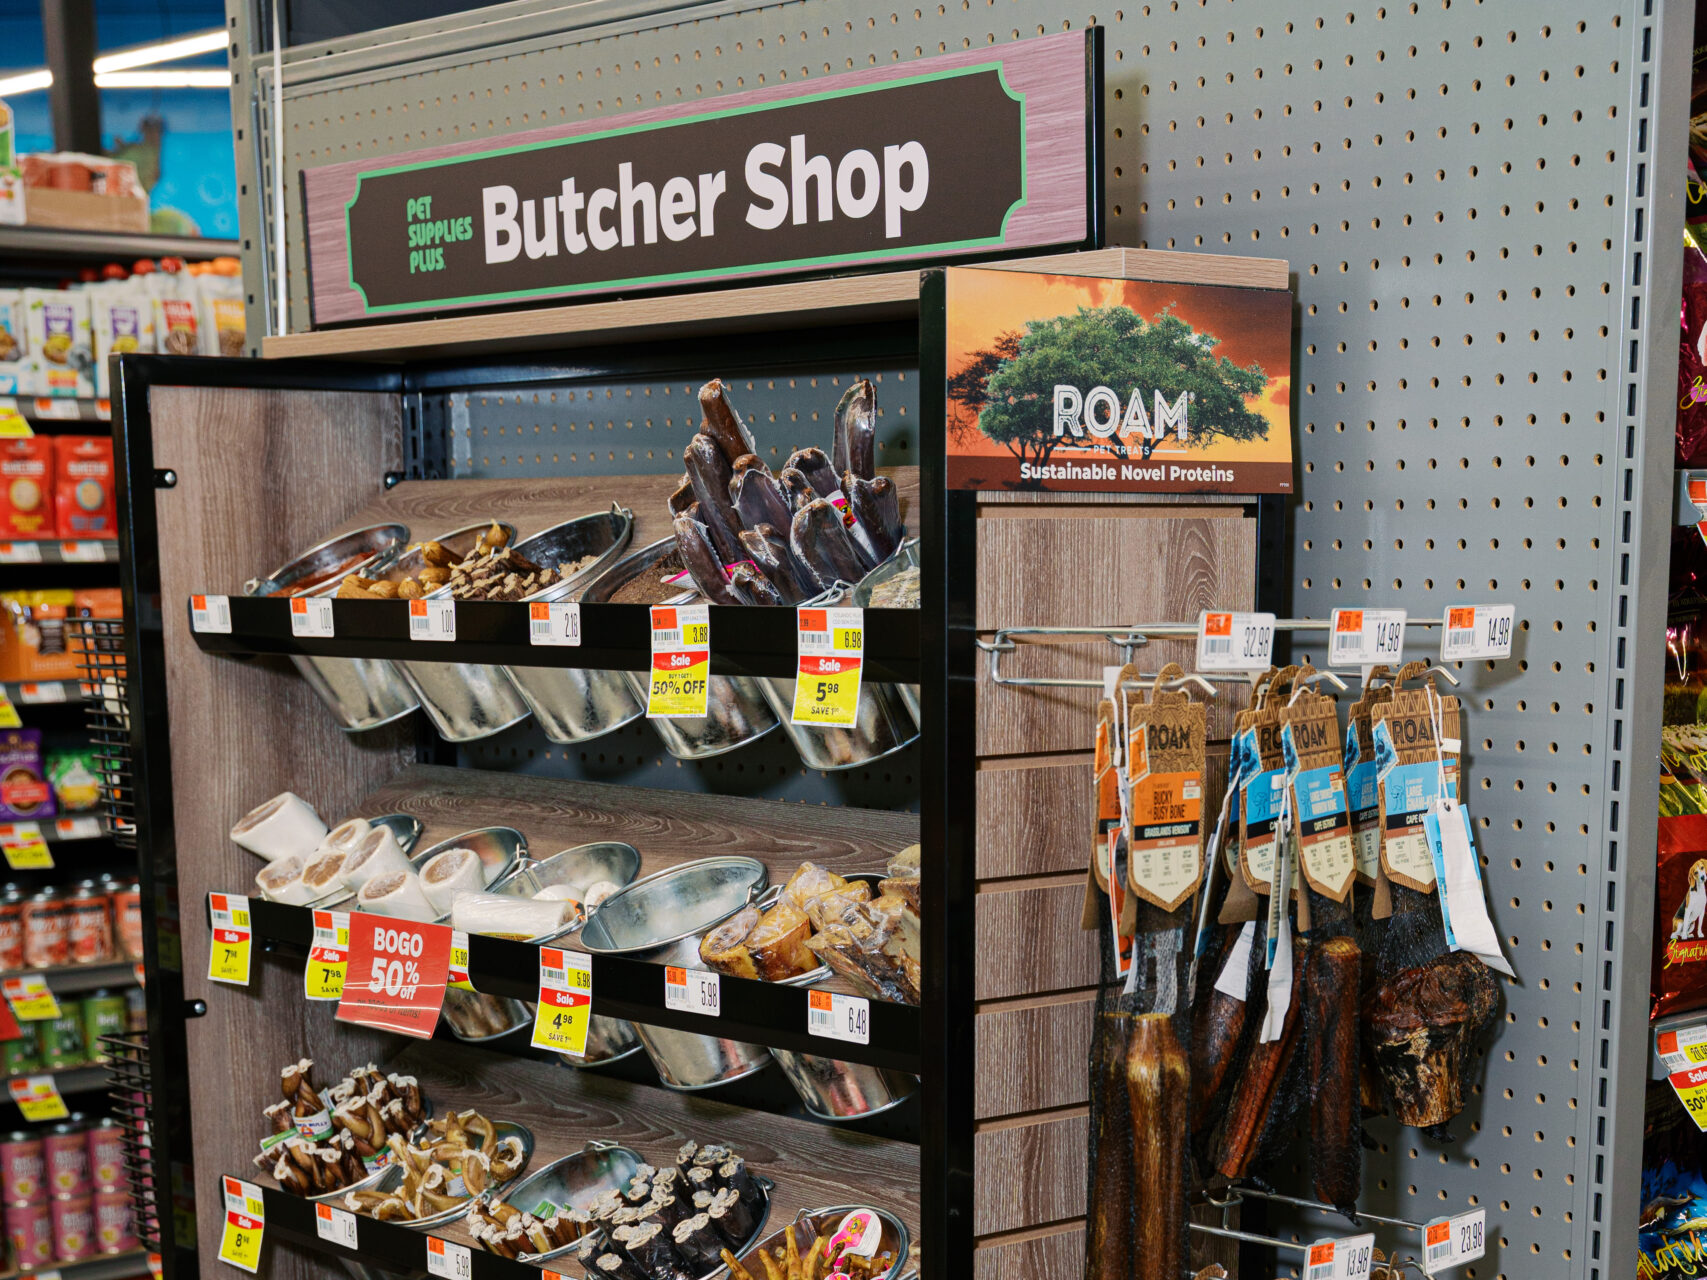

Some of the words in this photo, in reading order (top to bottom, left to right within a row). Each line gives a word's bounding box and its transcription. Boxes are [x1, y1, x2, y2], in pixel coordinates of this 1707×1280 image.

[406, 195, 432, 222] PET
[482, 162, 726, 265] Butcher
[744, 135, 929, 238] Shop
[408, 216, 474, 248] SUPPLIES
[409, 247, 445, 274] PLUS
[1053, 384, 1188, 440] ROAM
[1093, 445, 1113, 455] PET
[1115, 445, 1150, 456] TREATS
[1020, 462, 1118, 482] Sustainable
[1121, 464, 1166, 482] Novel
[1169, 464, 1235, 483] Proteins
[564, 612, 578, 638] 2.18
[693, 626, 708, 643] 3.68
[1376, 622, 1400, 654] 14.98
[1487, 616, 1511, 648] 14.98
[844, 631, 862, 648] 6.98
[1243, 626, 1270, 658] 32.98
[670, 653, 691, 666] Sale
[819, 658, 841, 672] Sale
[652, 681, 680, 695] 50%
[683, 680, 705, 695] OFF
[811, 705, 829, 716] SAVE
[1149, 724, 1191, 750] ROAM
[1293, 720, 1327, 749] ROAM
[1153, 791, 1174, 805] BUCKY
[1170, 804, 1186, 818] BONE
[224, 931, 239, 943] Sale
[373, 927, 423, 958] BOGO
[322, 950, 340, 962] Sale
[368, 956, 420, 997] 50%
[577, 972, 591, 988] 5.98
[400, 985, 417, 1000] off
[556, 992, 574, 1006] Sale
[701, 981, 717, 1008] 5.98
[849, 1006, 867, 1036] 6.48
[548, 1032, 563, 1043] SAVE
[1460, 1220, 1483, 1254] 23.98
[1346, 1246, 1369, 1277] 13.98
